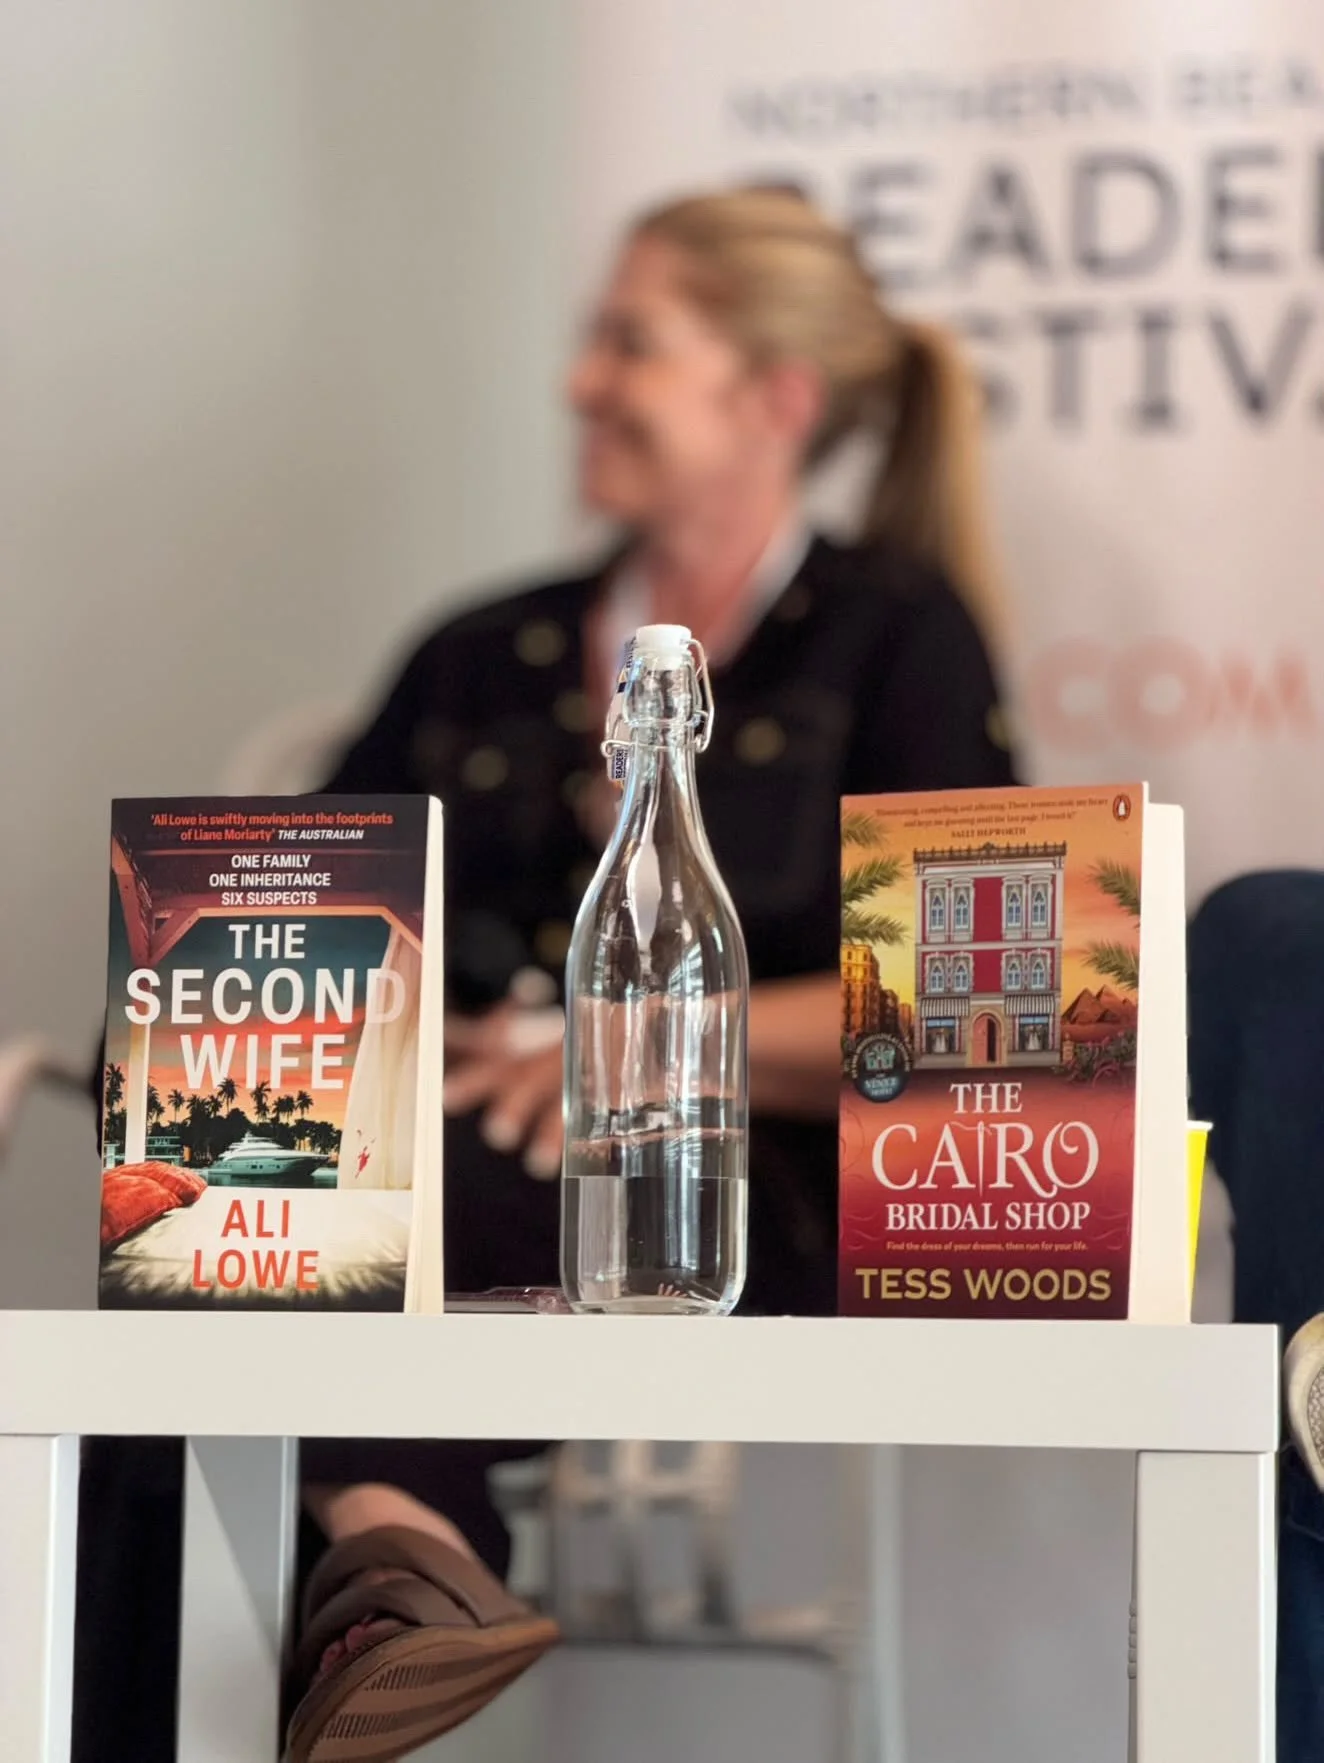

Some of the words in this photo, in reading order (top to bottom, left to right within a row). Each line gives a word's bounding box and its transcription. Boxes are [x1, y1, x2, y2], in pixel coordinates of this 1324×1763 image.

[846, 142, 1324, 290] EADE
[169, 814, 197, 826] Lowe
[199, 813, 209, 825] is
[210, 813, 247, 827] swiftly
[249, 812, 290, 827] moving
[291, 812, 314, 825] into
[315, 812, 335, 825] the
[336, 812, 394, 827] footprints
[180, 828, 193, 841] of
[194, 829, 222, 841] Liane
[278, 829, 298, 840] THE
[299, 829, 365, 840] AUSTRALIAN
[231, 854, 261, 868] ONE
[262, 854, 311, 868] FAMILY
[209, 873, 238, 887] ONE
[240, 872, 331, 887] INHERITANCE
[221, 892, 244, 906] SIX
[246, 891, 317, 905] SUSPECTS
[228, 923, 307, 960] THE
[124, 967, 406, 1025] SECOND
[180, 1033, 346, 1090] WIFE
[950, 1082, 1023, 1114] THE
[871, 1120, 1100, 1199] CAIRO
[220, 1199, 291, 1239] ALI
[885, 1202, 998, 1231] BRIDAL
[1005, 1201, 1091, 1231] SHOP
[887, 1241, 905, 1250] Find
[906, 1241, 920, 1250] the
[920, 1241, 943, 1251] dress
[943, 1241, 953, 1250] of
[954, 1243, 972, 1253] your
[1005, 1241, 1025, 1251] then
[1025, 1243, 1040, 1251] run
[1041, 1240, 1054, 1251] for
[1054, 1243, 1073, 1252] your
[192, 1249, 320, 1290] LOWE
[855, 1267, 952, 1301] TESS
[963, 1267, 1111, 1301] WOODS
